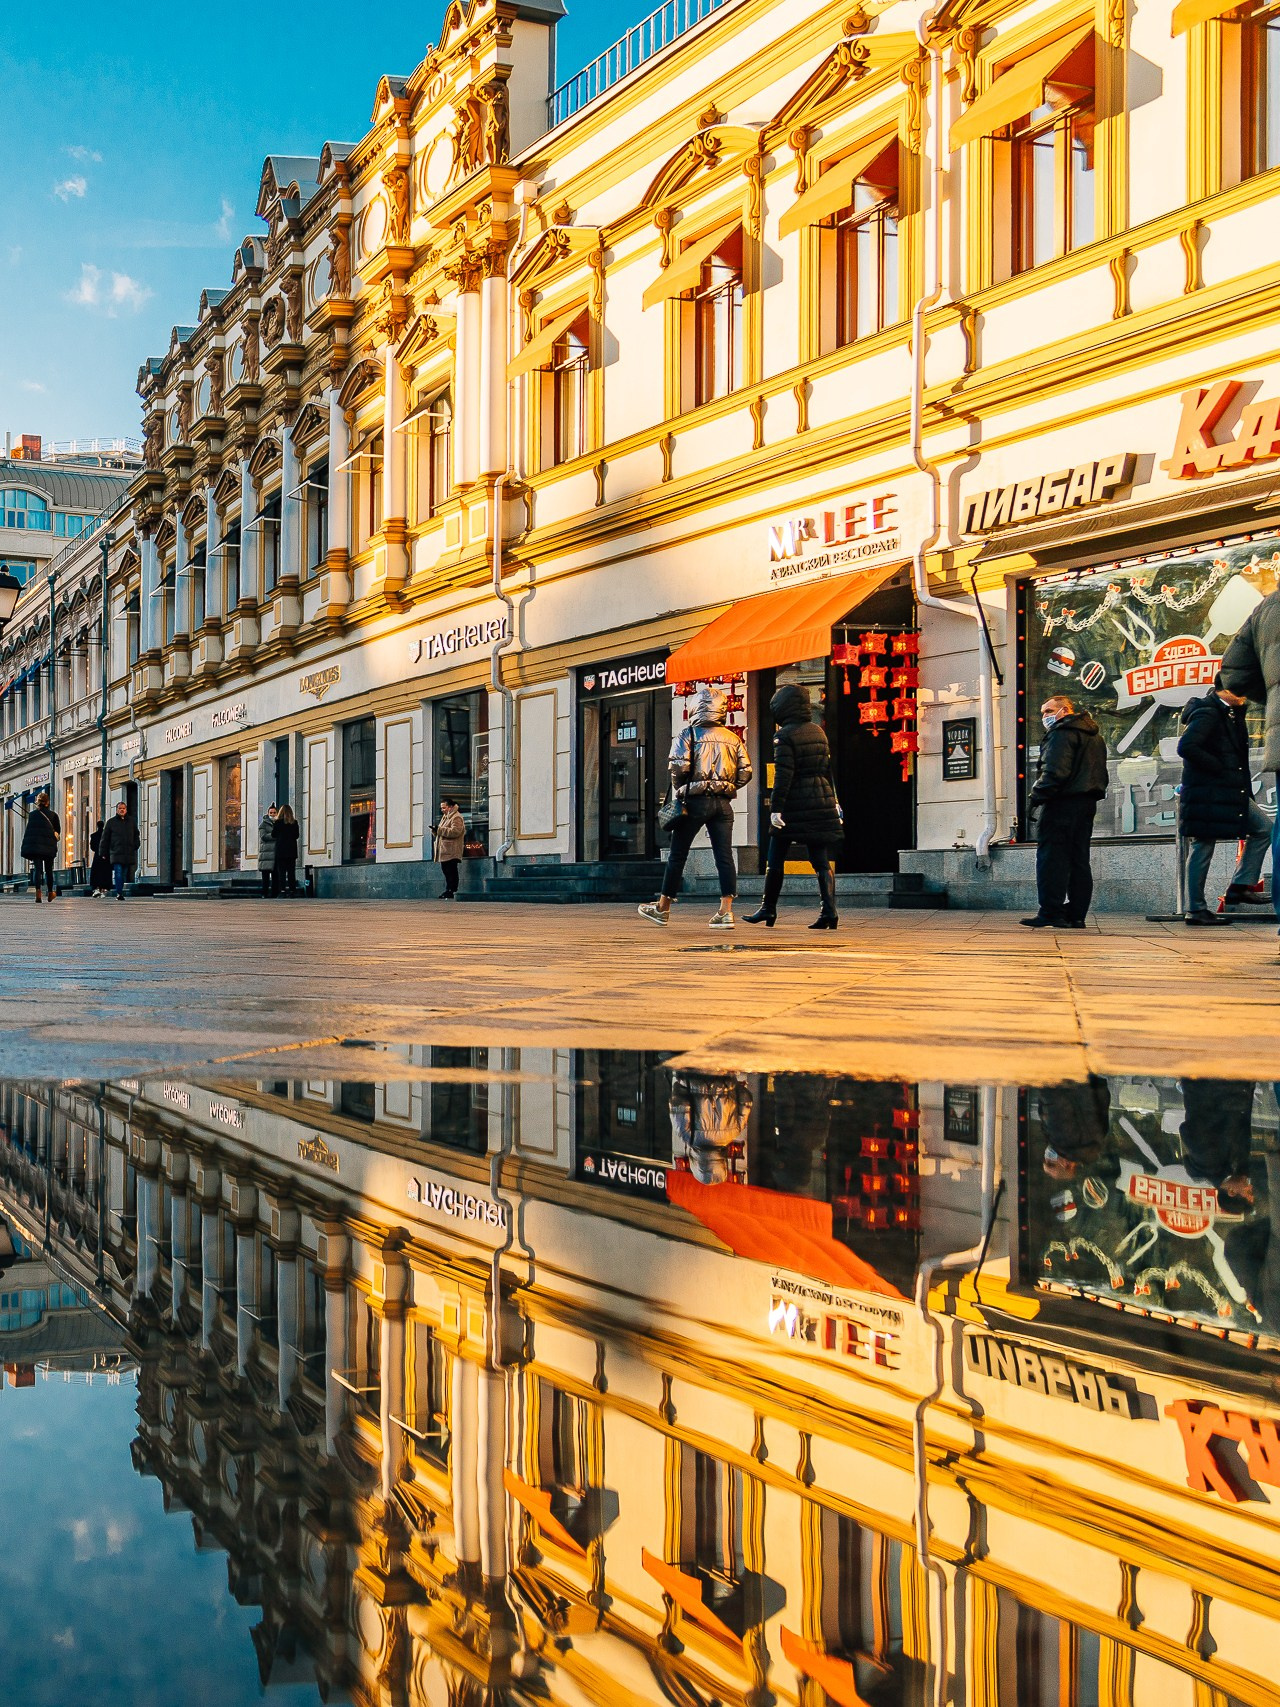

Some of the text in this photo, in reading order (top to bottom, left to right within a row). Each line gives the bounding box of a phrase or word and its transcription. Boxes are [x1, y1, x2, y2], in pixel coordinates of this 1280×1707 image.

[959, 453, 1134, 534] ПИВБАР
[1163, 644, 1200, 660] ЗДЕСЬ
[599, 662, 666, 688] TAGHeue
